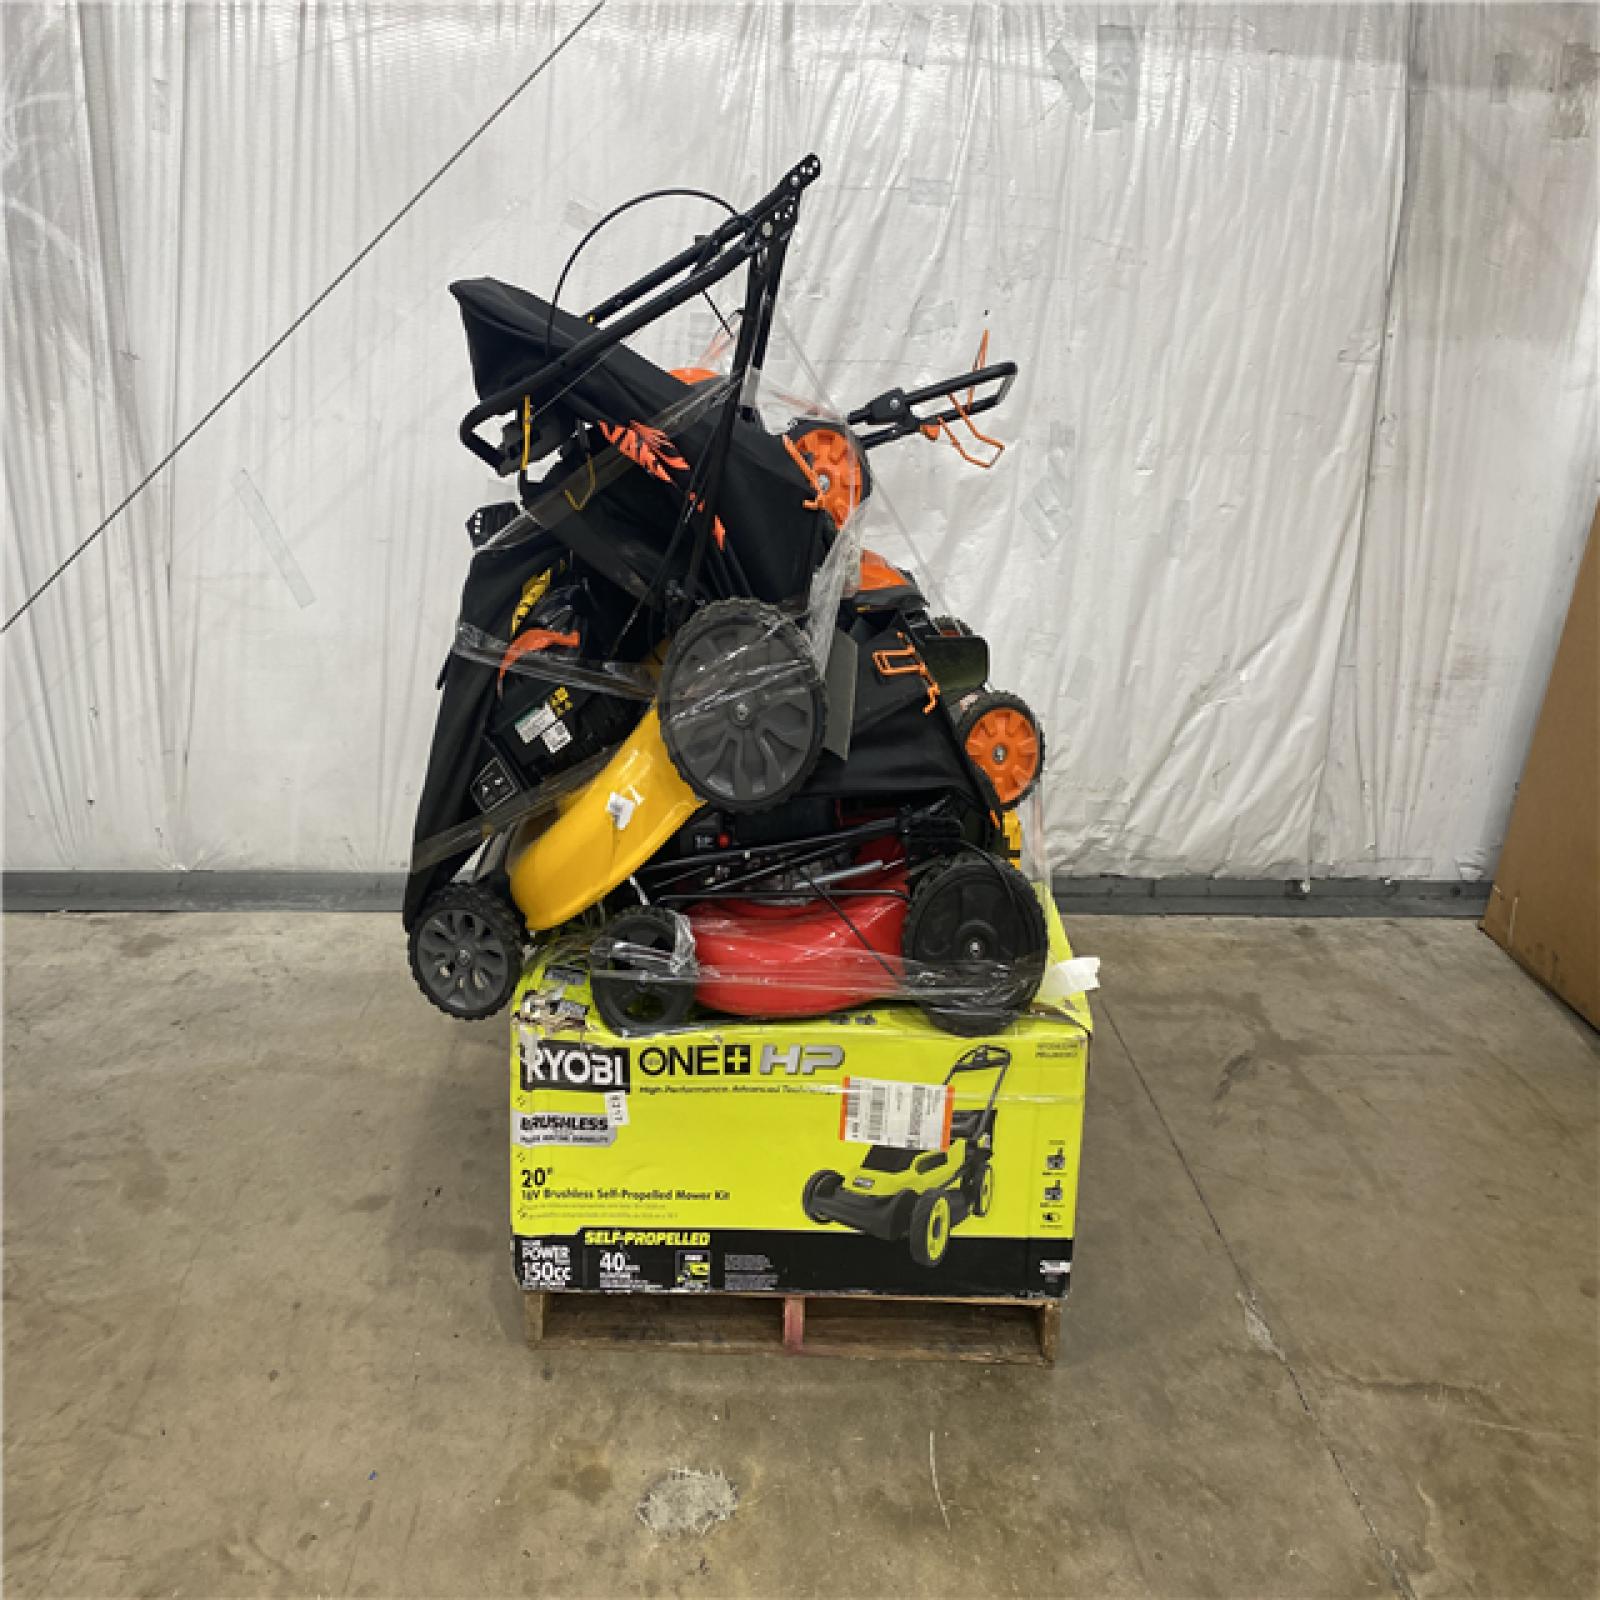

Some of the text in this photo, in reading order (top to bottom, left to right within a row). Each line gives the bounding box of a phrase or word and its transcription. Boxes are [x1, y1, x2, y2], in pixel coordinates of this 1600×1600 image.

[760, 1045, 845, 1076] HP
[545, 1189, 593, 1199] Brushless
[676, 1190, 712, 1200] Mower
[715, 1190, 731, 1200] Kit
[584, 1231, 710, 1246] SELF-PROPELLED
